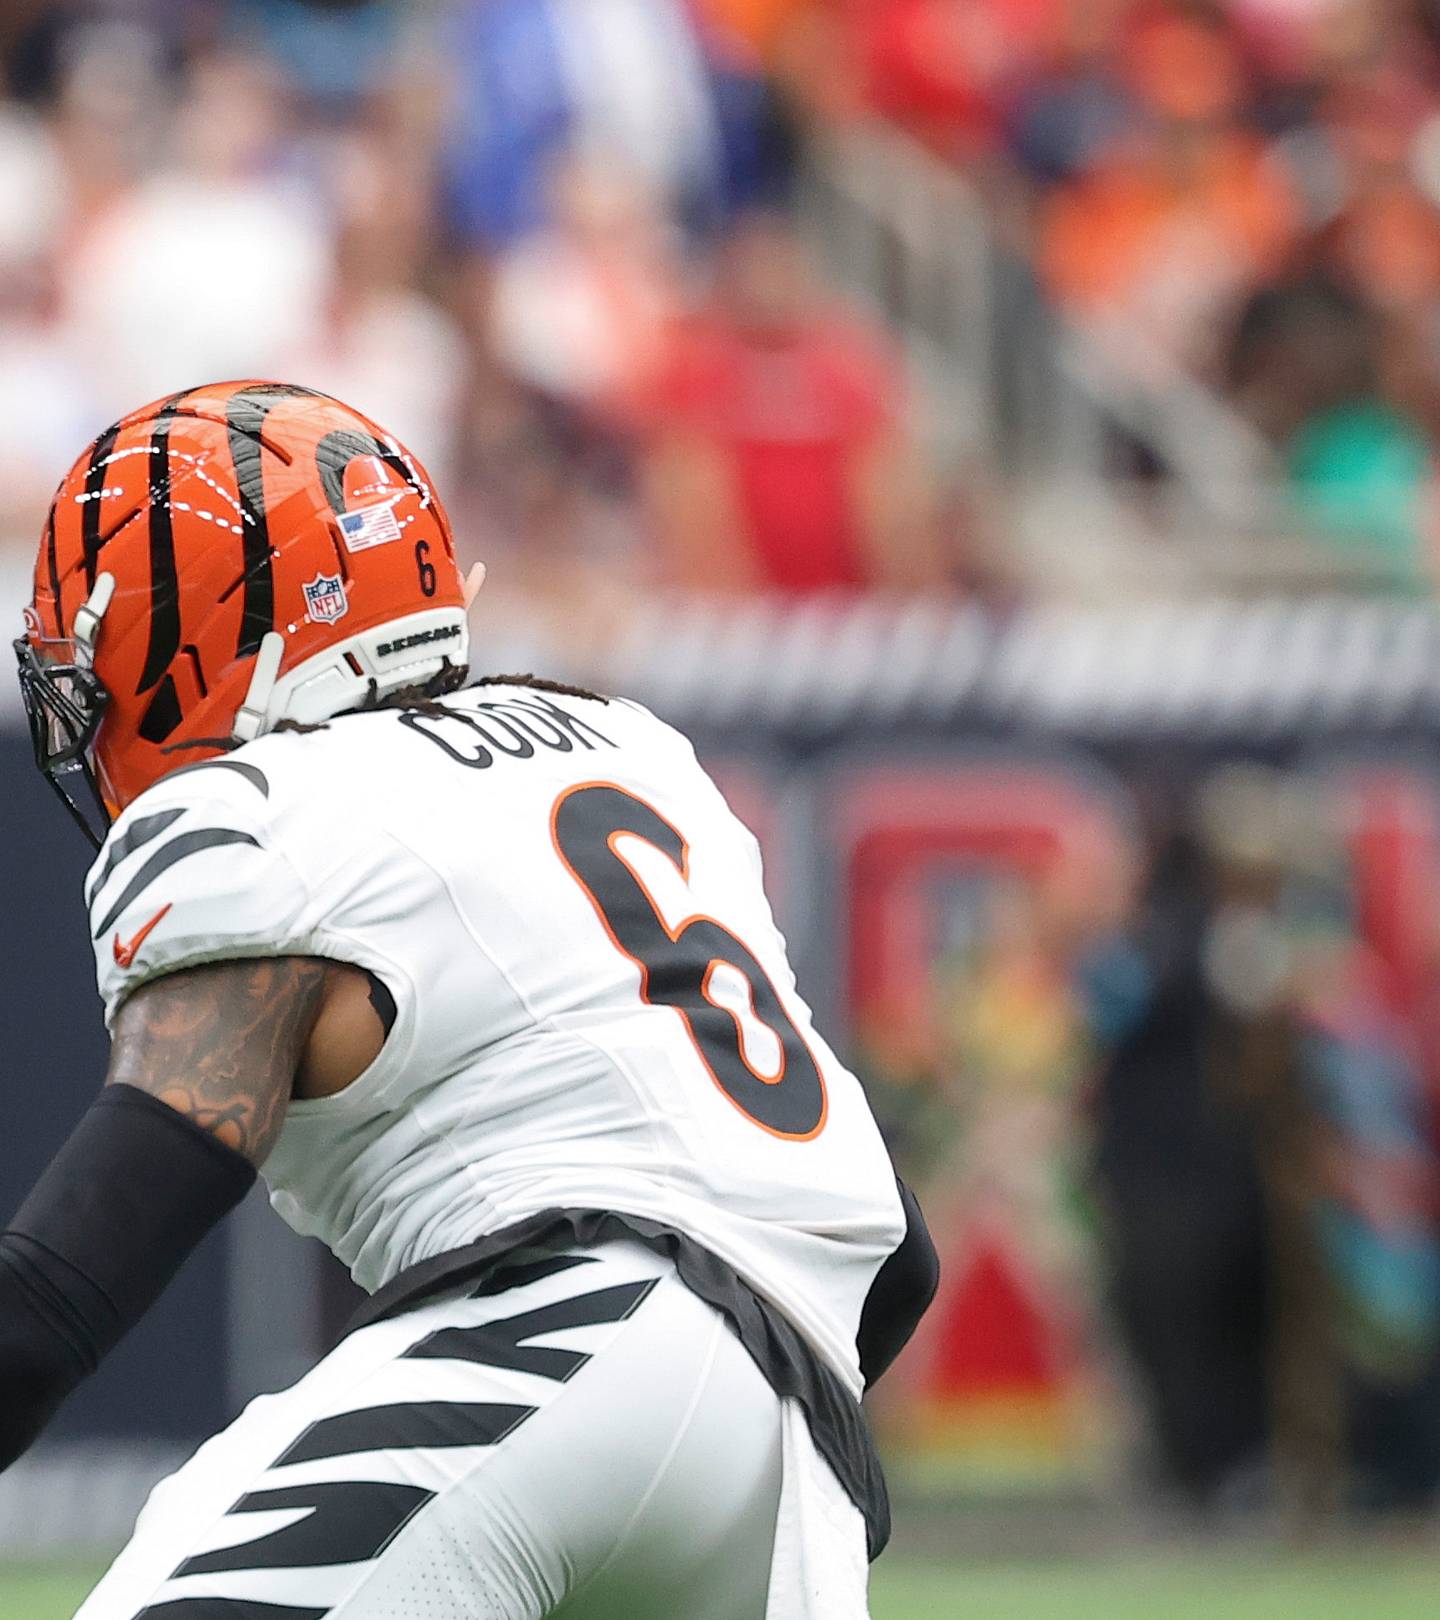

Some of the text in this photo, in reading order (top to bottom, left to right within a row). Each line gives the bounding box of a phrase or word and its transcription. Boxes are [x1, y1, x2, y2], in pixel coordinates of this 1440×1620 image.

[415, 540, 437, 597] 6
[312, 594, 343, 616] NFL
[398, 696, 621, 769] COOK
[549, 780, 828, 1142] 6
